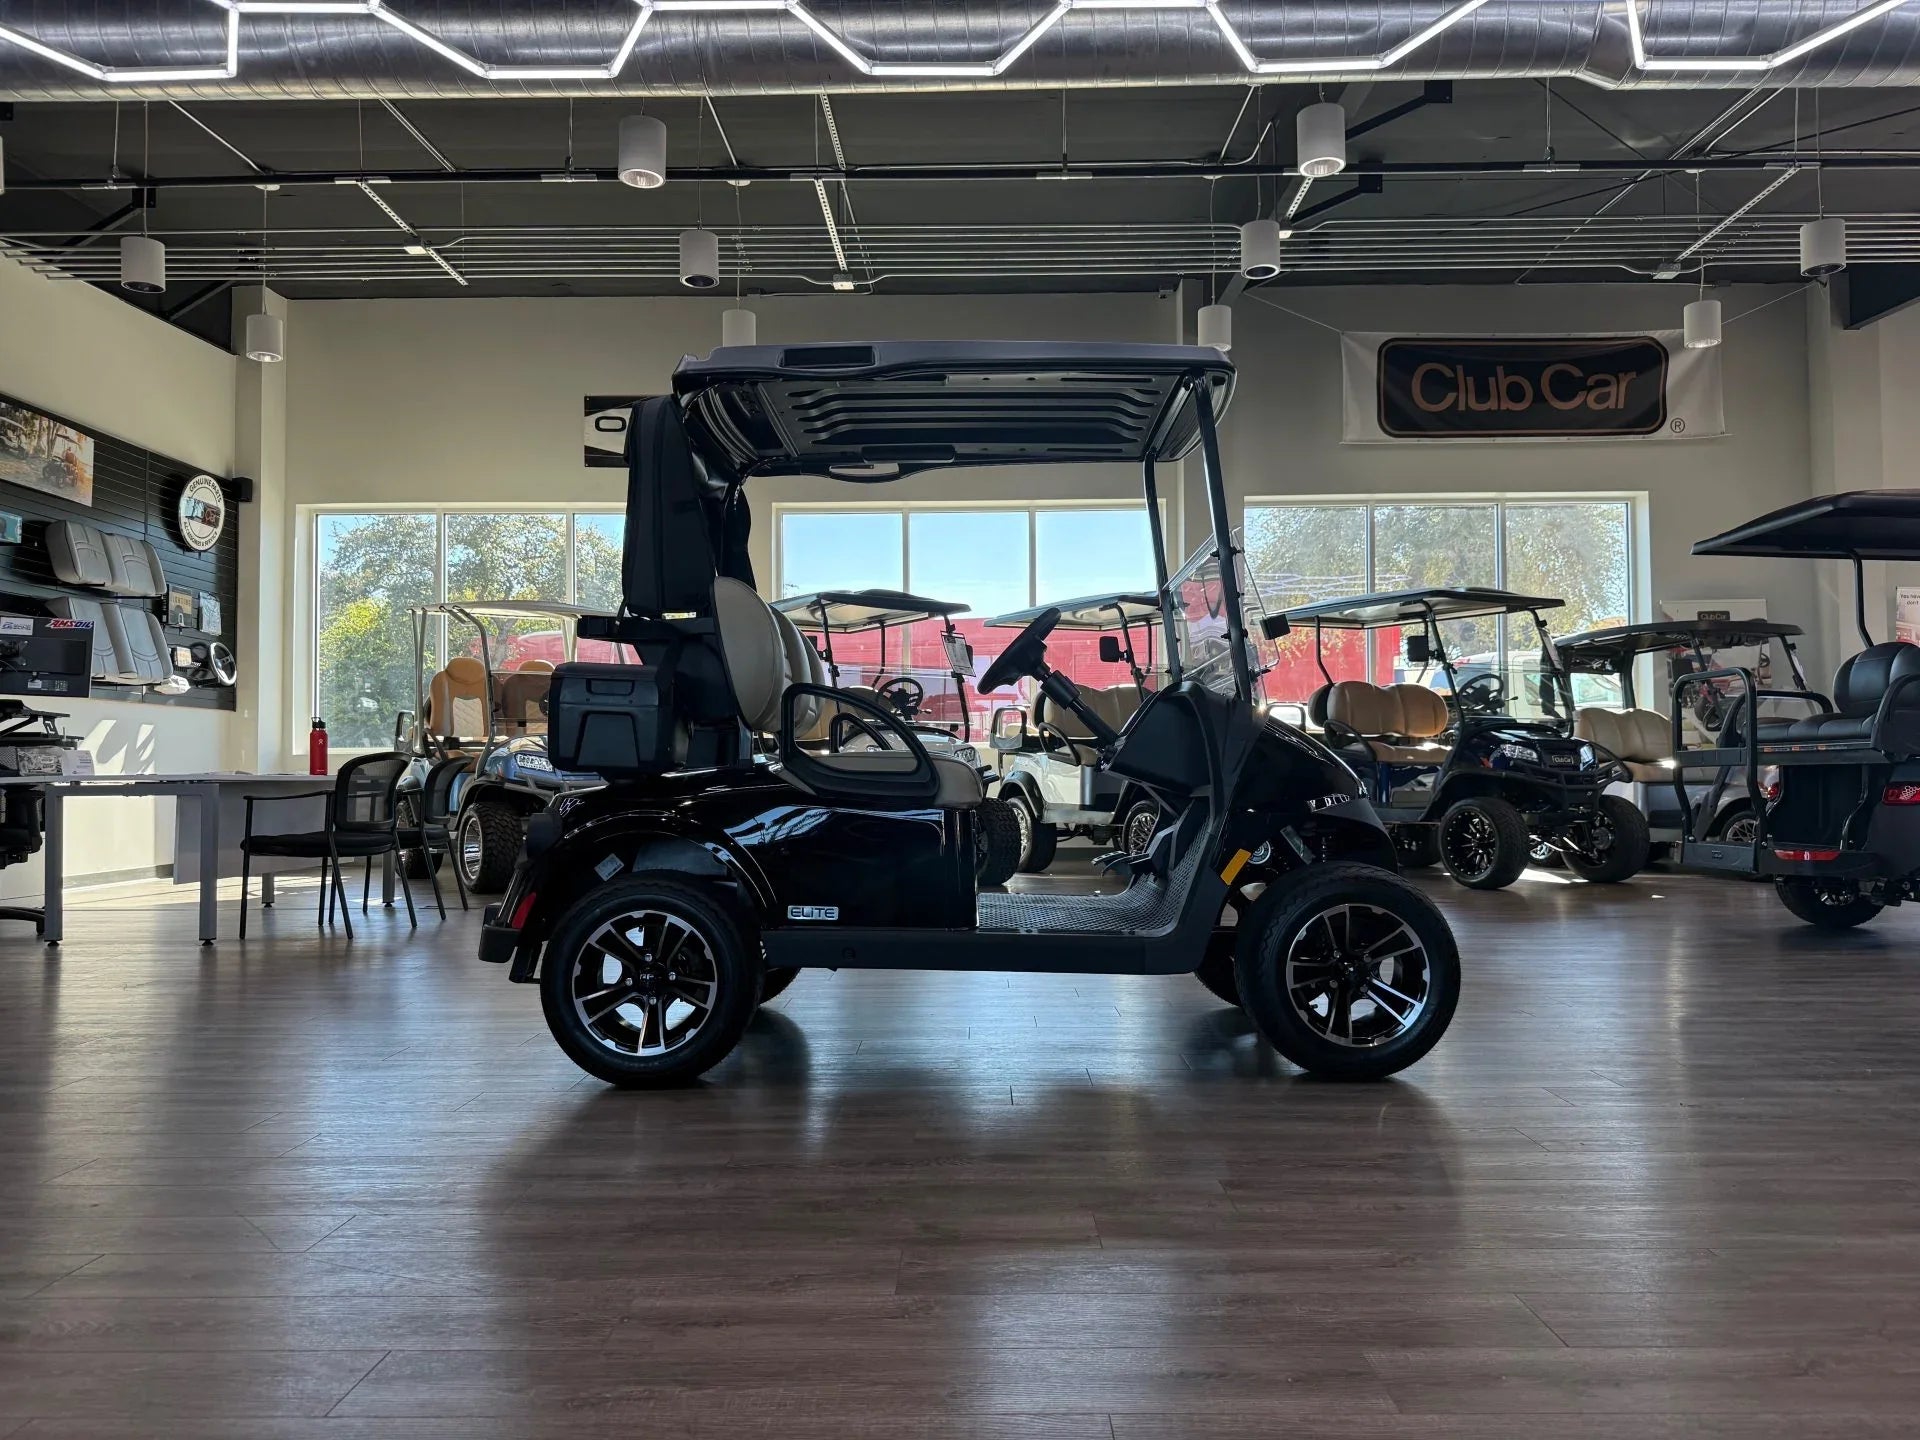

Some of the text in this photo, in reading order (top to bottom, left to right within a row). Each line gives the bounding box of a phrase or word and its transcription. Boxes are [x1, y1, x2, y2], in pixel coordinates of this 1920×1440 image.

[1411, 362, 1636, 413] Club Car
[189, 478, 222, 503] GENUINE PARTS
[50, 619, 94, 629] AMSOIL
[791, 907, 835, 919] ELITE
